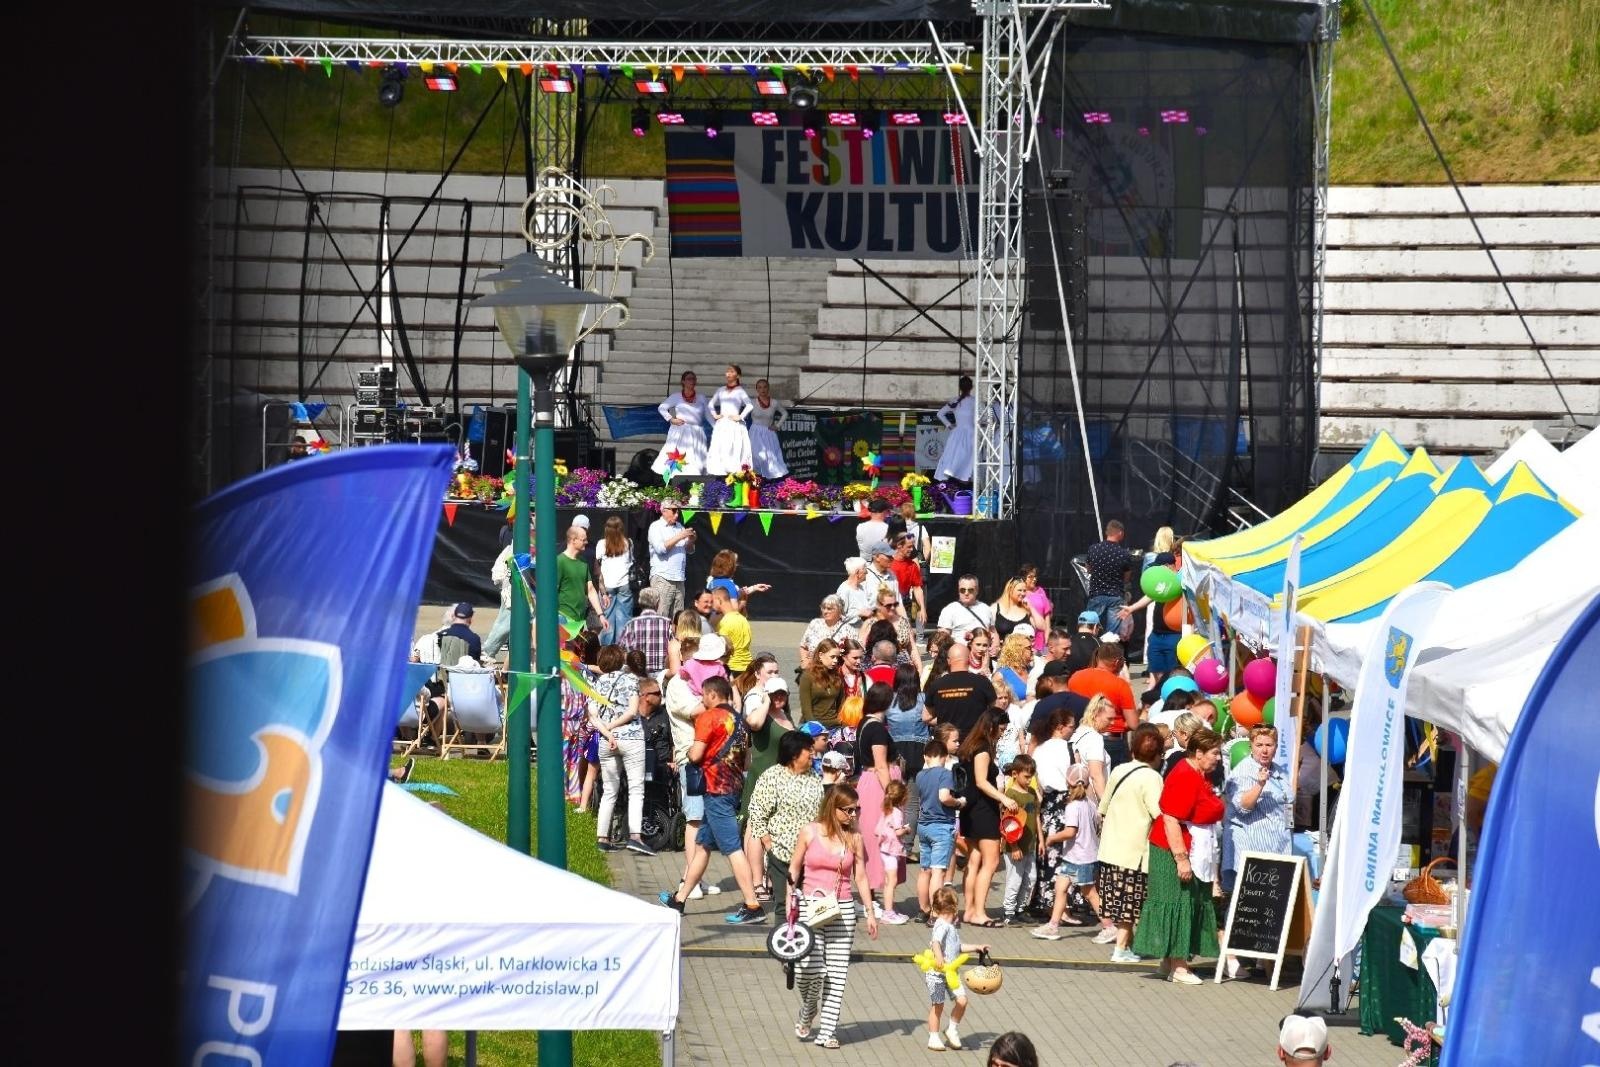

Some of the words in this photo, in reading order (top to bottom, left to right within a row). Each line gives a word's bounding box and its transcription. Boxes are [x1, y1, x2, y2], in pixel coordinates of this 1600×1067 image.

[1364, 831, 1378, 892] GMINA
[349, 956, 418, 971] odzisław
[422, 953, 469, 974] Śląski,
[475, 956, 494, 971] ul.
[499, 956, 598, 971] Marklowicka
[603, 957, 621, 971] 15
[359, 980, 379, 995] 26
[384, 980, 407, 998] 36,
[413, 979, 599, 999] www.pwik-wodzislaw.pl
